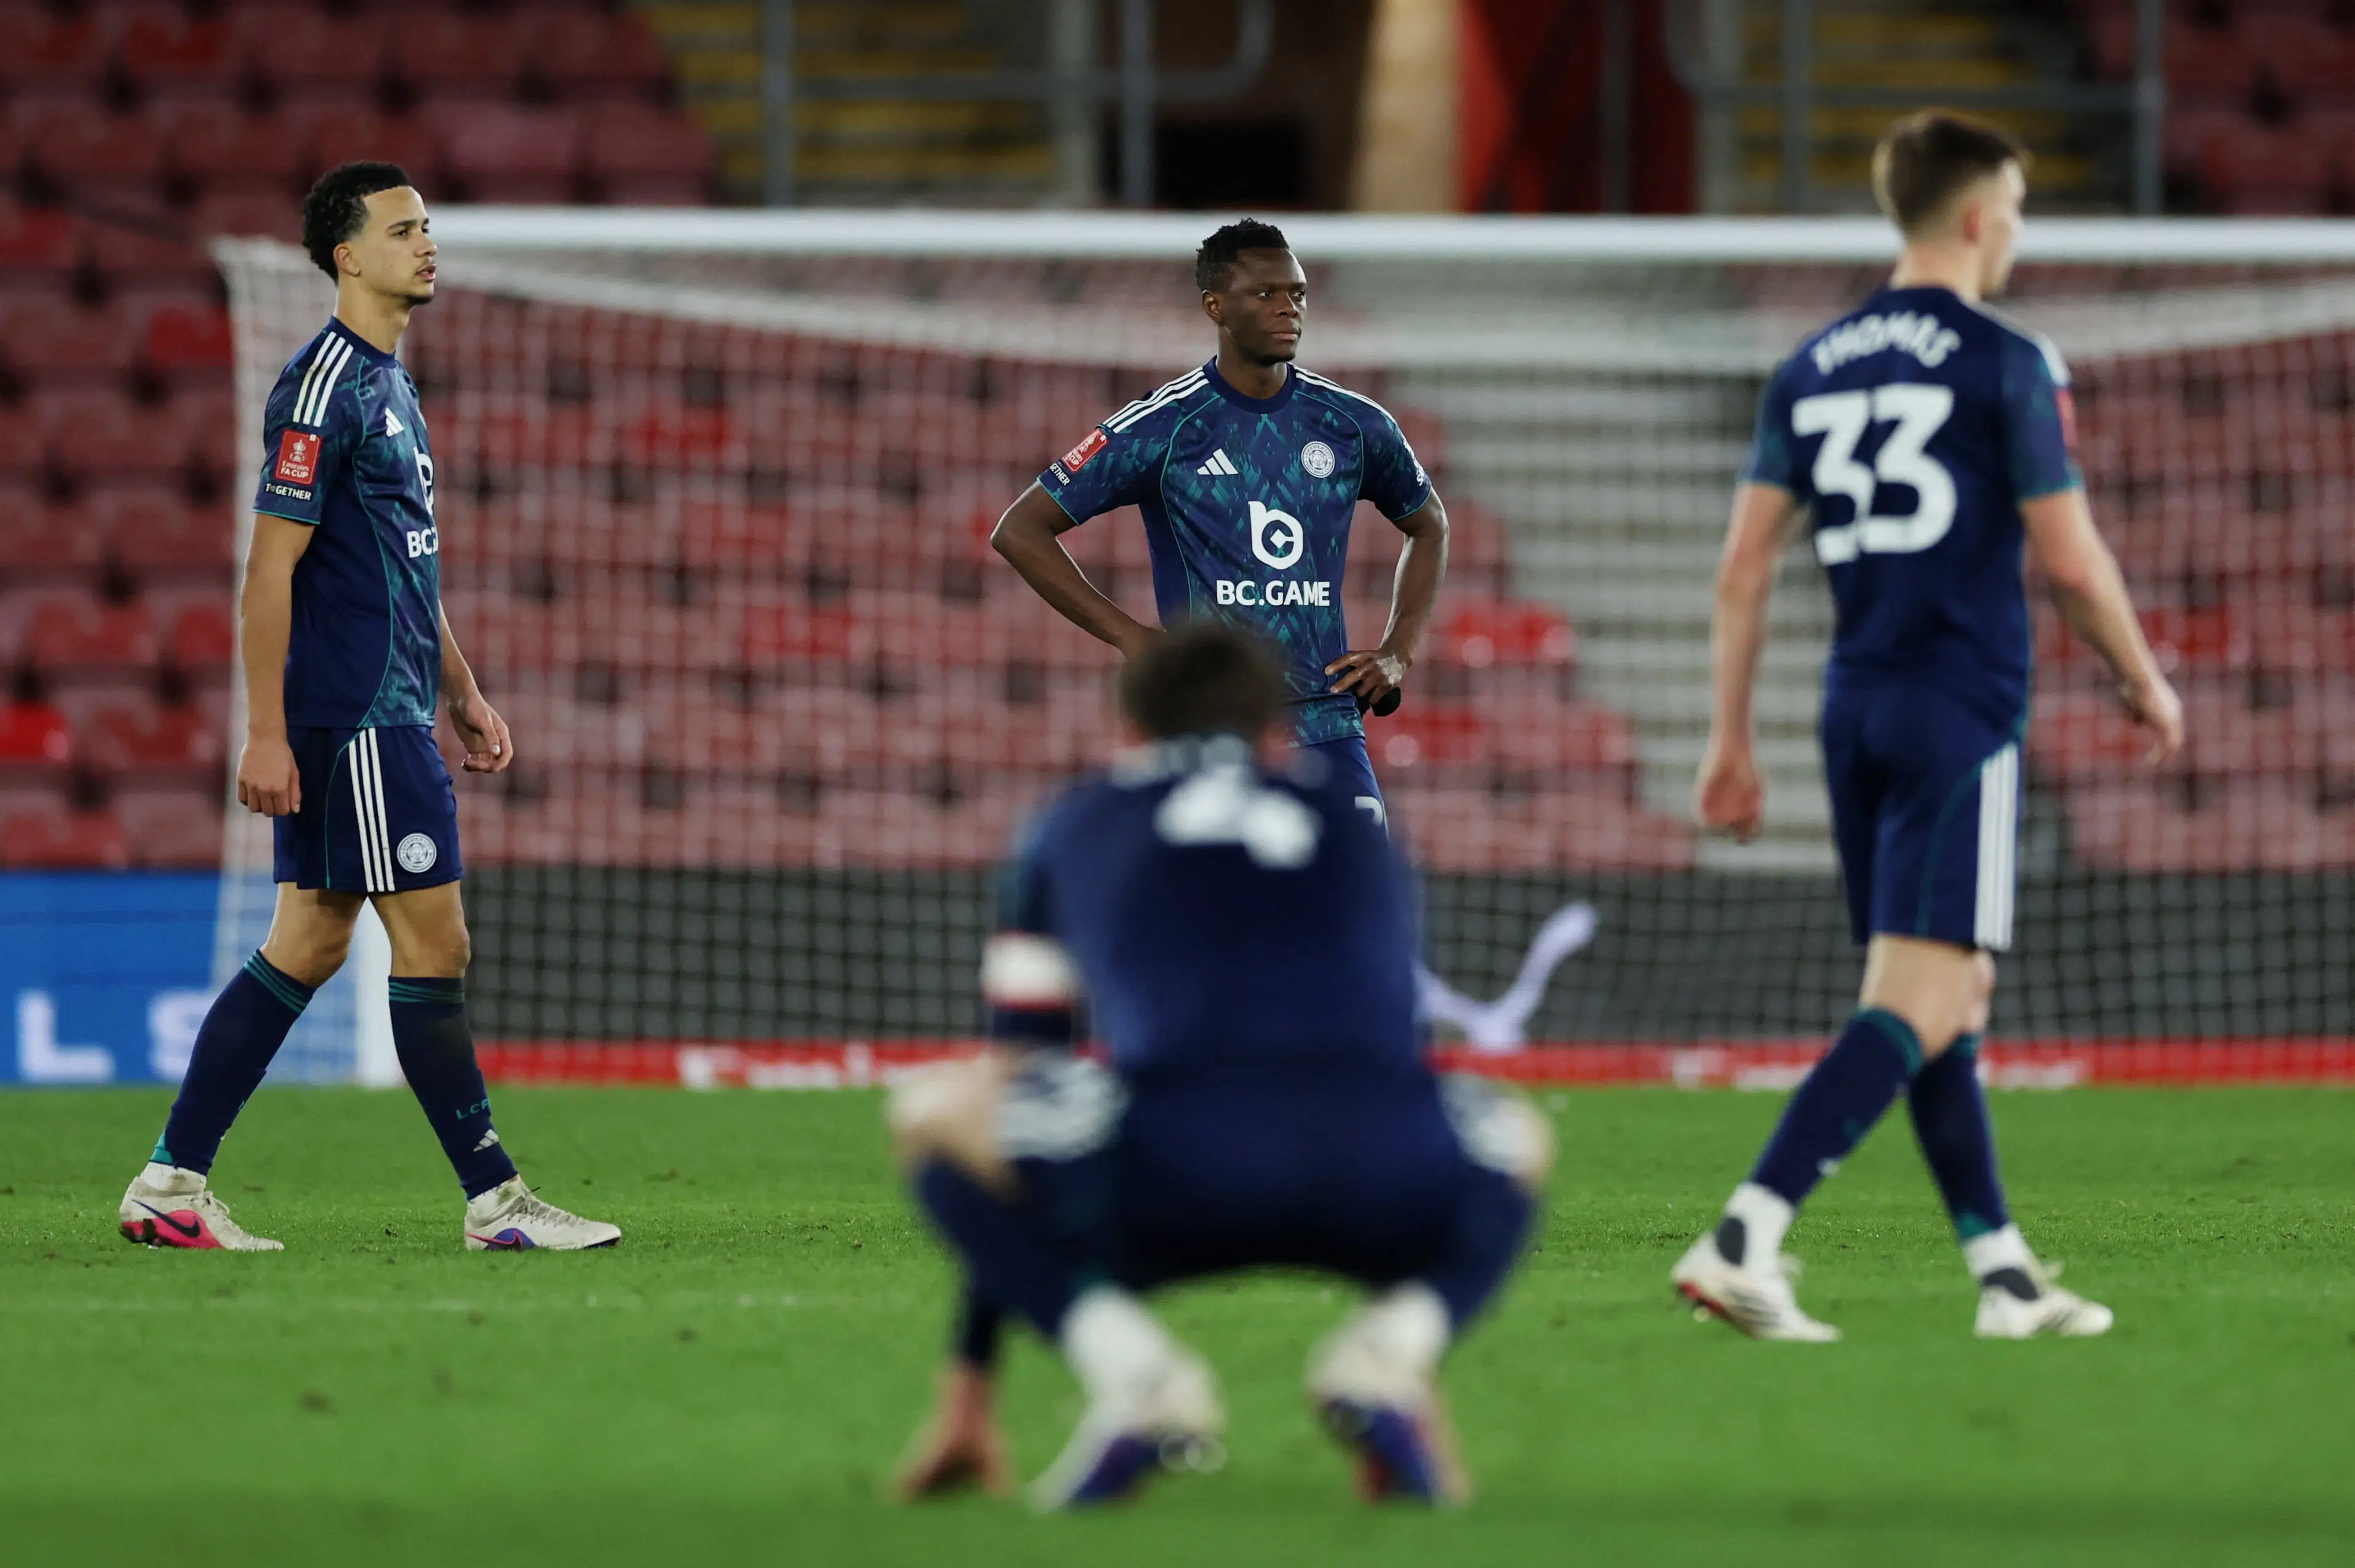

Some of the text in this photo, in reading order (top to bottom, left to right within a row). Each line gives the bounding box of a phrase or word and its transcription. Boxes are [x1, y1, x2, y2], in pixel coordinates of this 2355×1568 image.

[280, 467, 309, 478] FA CUP
[282, 460, 310, 472] Emirates
[1791, 381, 1958, 566] 33
[407, 528, 438, 558] BC
[1217, 580, 1330, 606] BC.GAME
[456, 1097, 491, 1120] LCF
